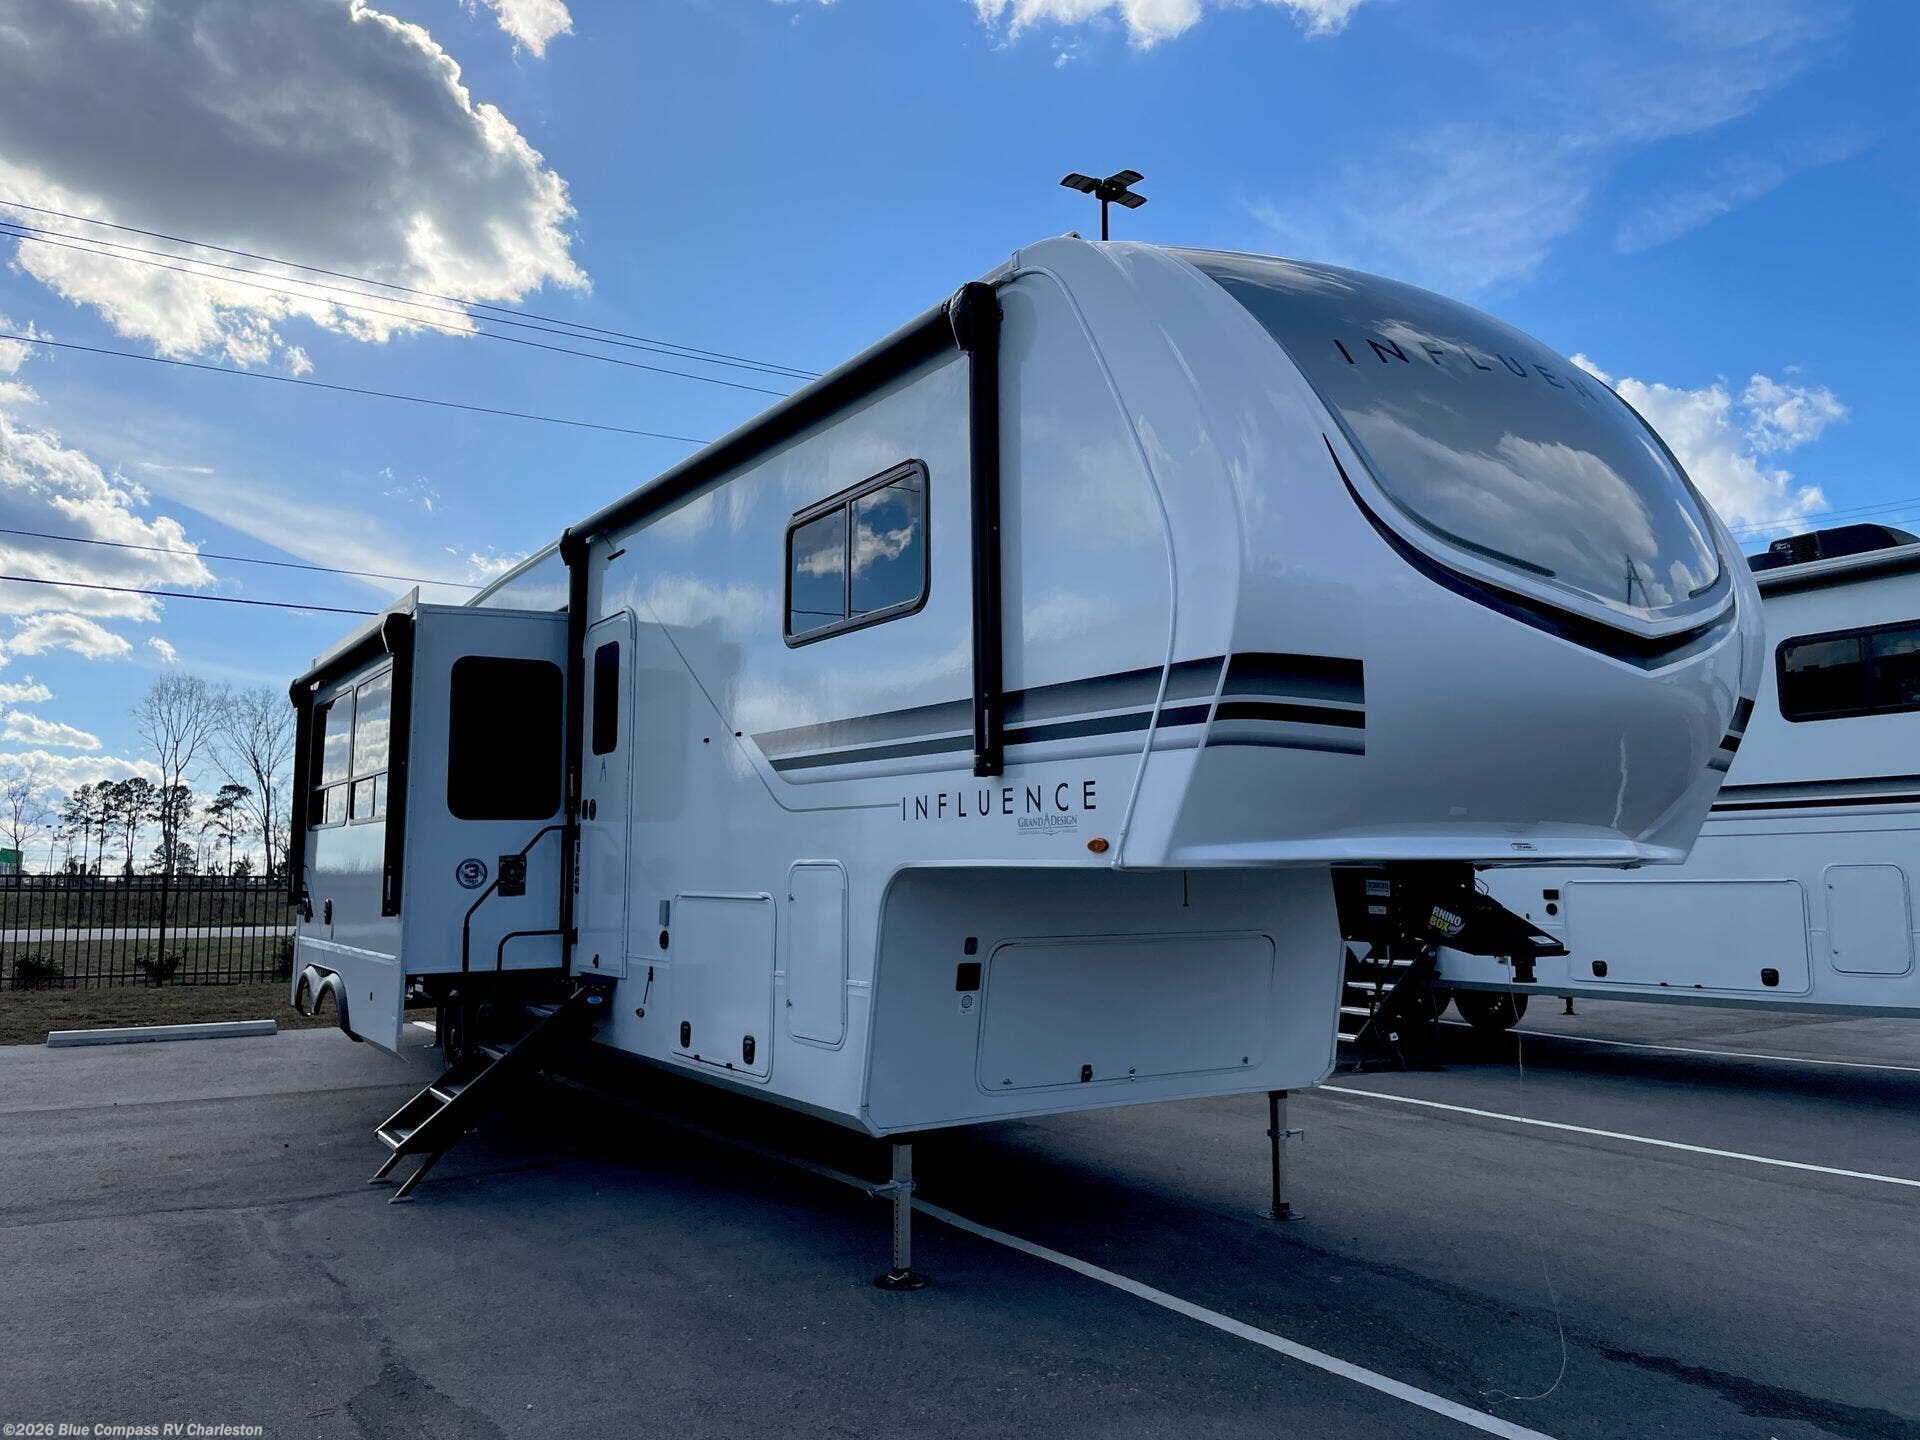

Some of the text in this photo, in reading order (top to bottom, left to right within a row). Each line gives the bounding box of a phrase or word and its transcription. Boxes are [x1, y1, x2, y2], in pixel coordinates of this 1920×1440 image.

[1333, 338, 1600, 404] INFLUEN
[902, 780, 1097, 821] INFLUENCE
[1429, 915, 1450, 932] BOX
[1432, 906, 1462, 926] RHINO
